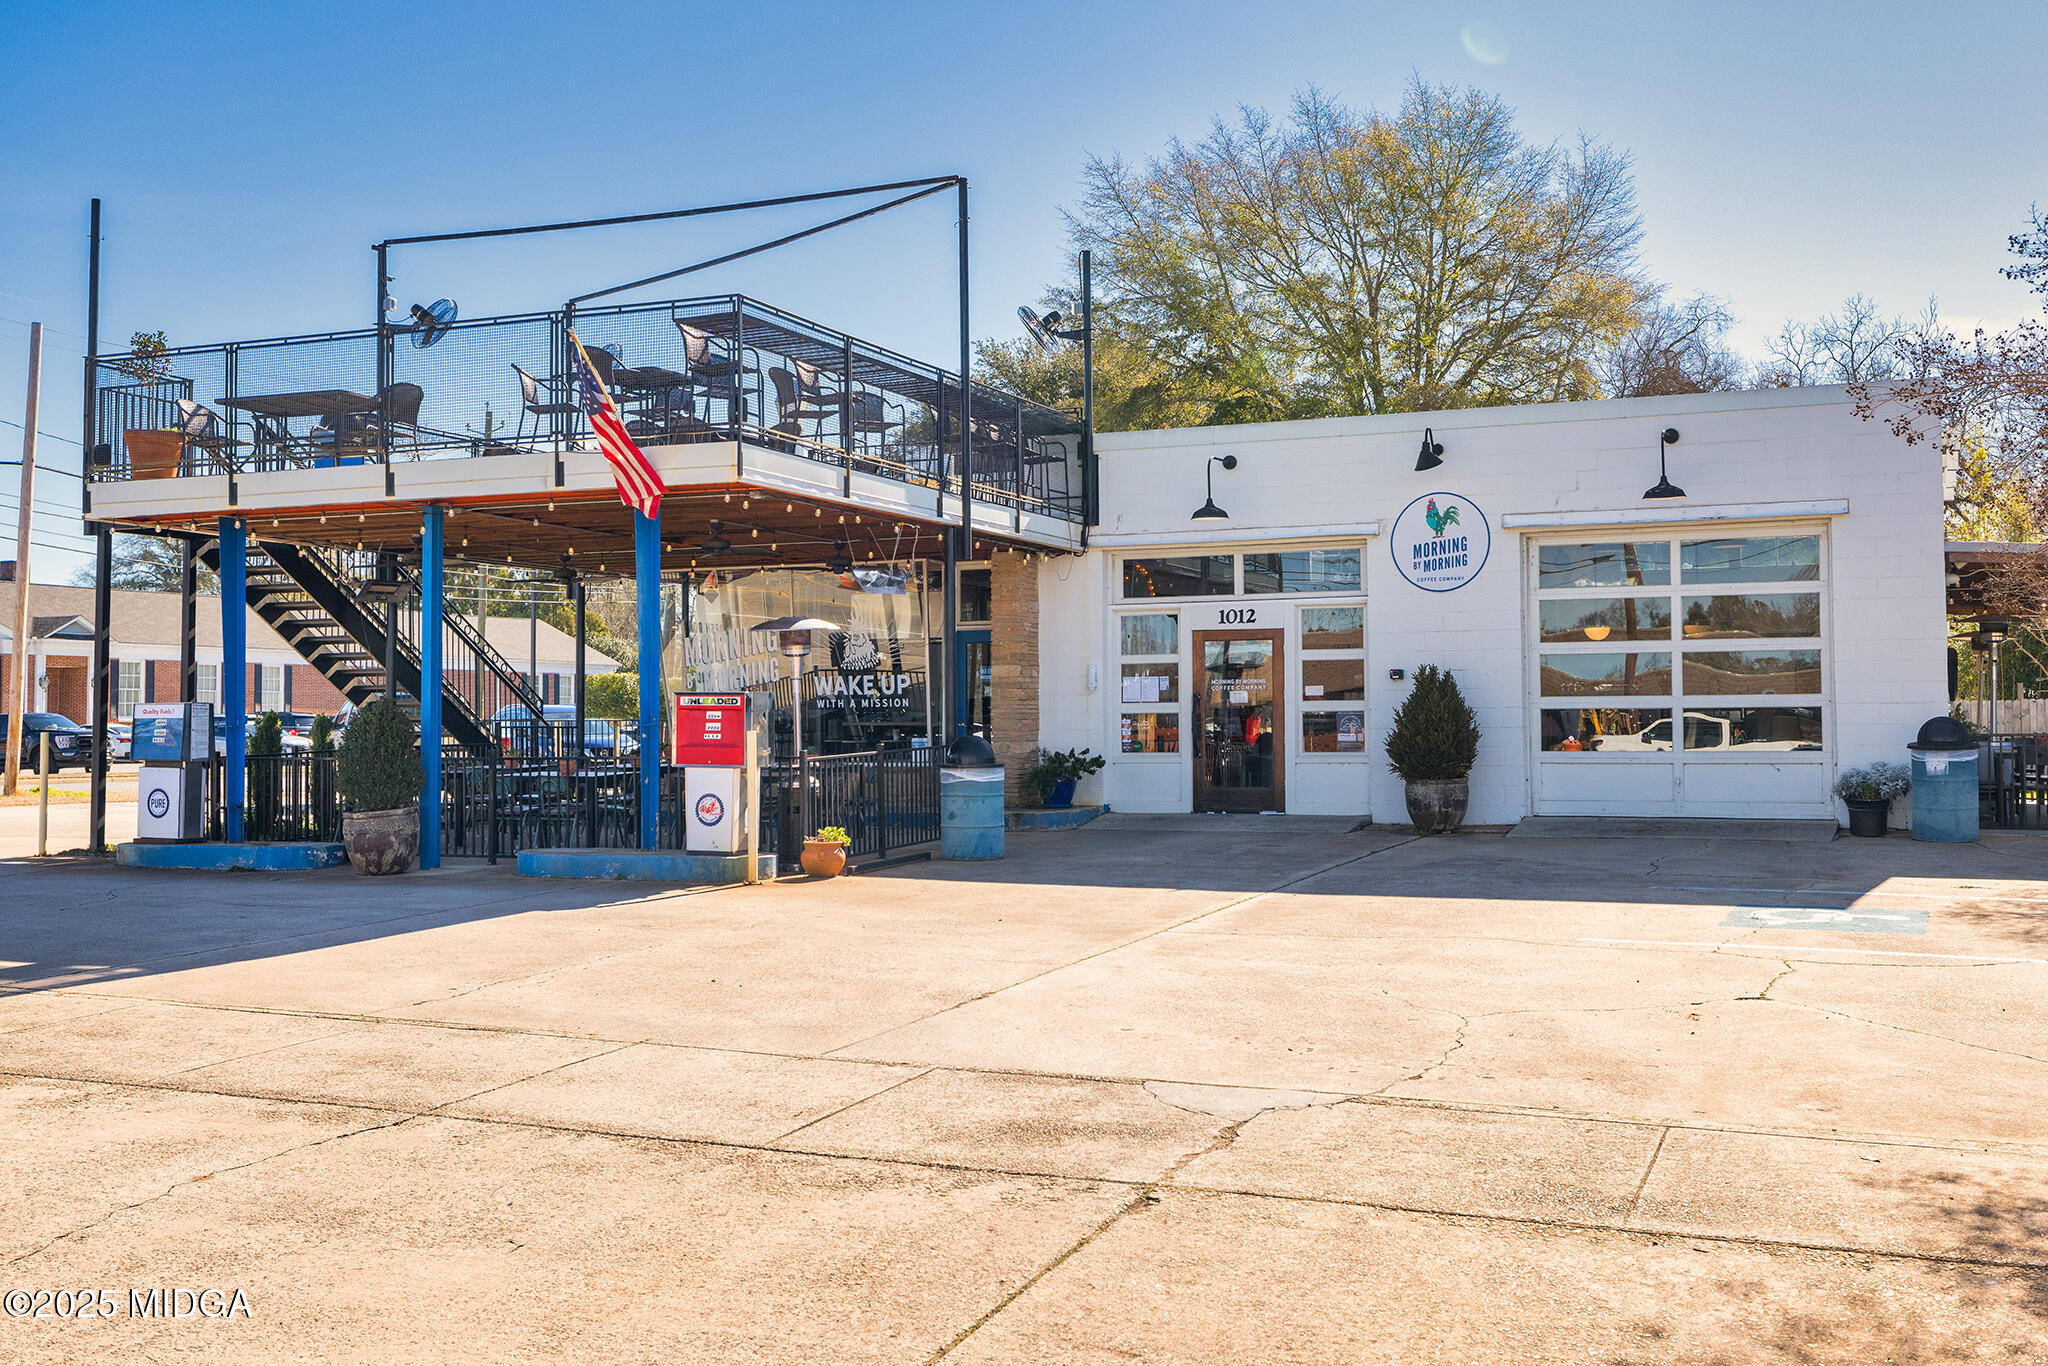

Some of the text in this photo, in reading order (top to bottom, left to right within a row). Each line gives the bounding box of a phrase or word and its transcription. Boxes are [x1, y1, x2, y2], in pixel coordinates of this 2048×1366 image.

[1413, 536, 1468, 560] MORNING
[1413, 553, 1468, 573] BY MORNING
[1218, 608, 1257, 625] 1012
[684, 627, 778, 668] MORNING
[813, 674, 911, 696] WAKE UP
[682, 697, 739, 705] UNLEADED
[816, 698, 910, 708] WITH A MISSION
[142, 708, 159, 716] Quality
[150, 798, 166, 809] PURE
